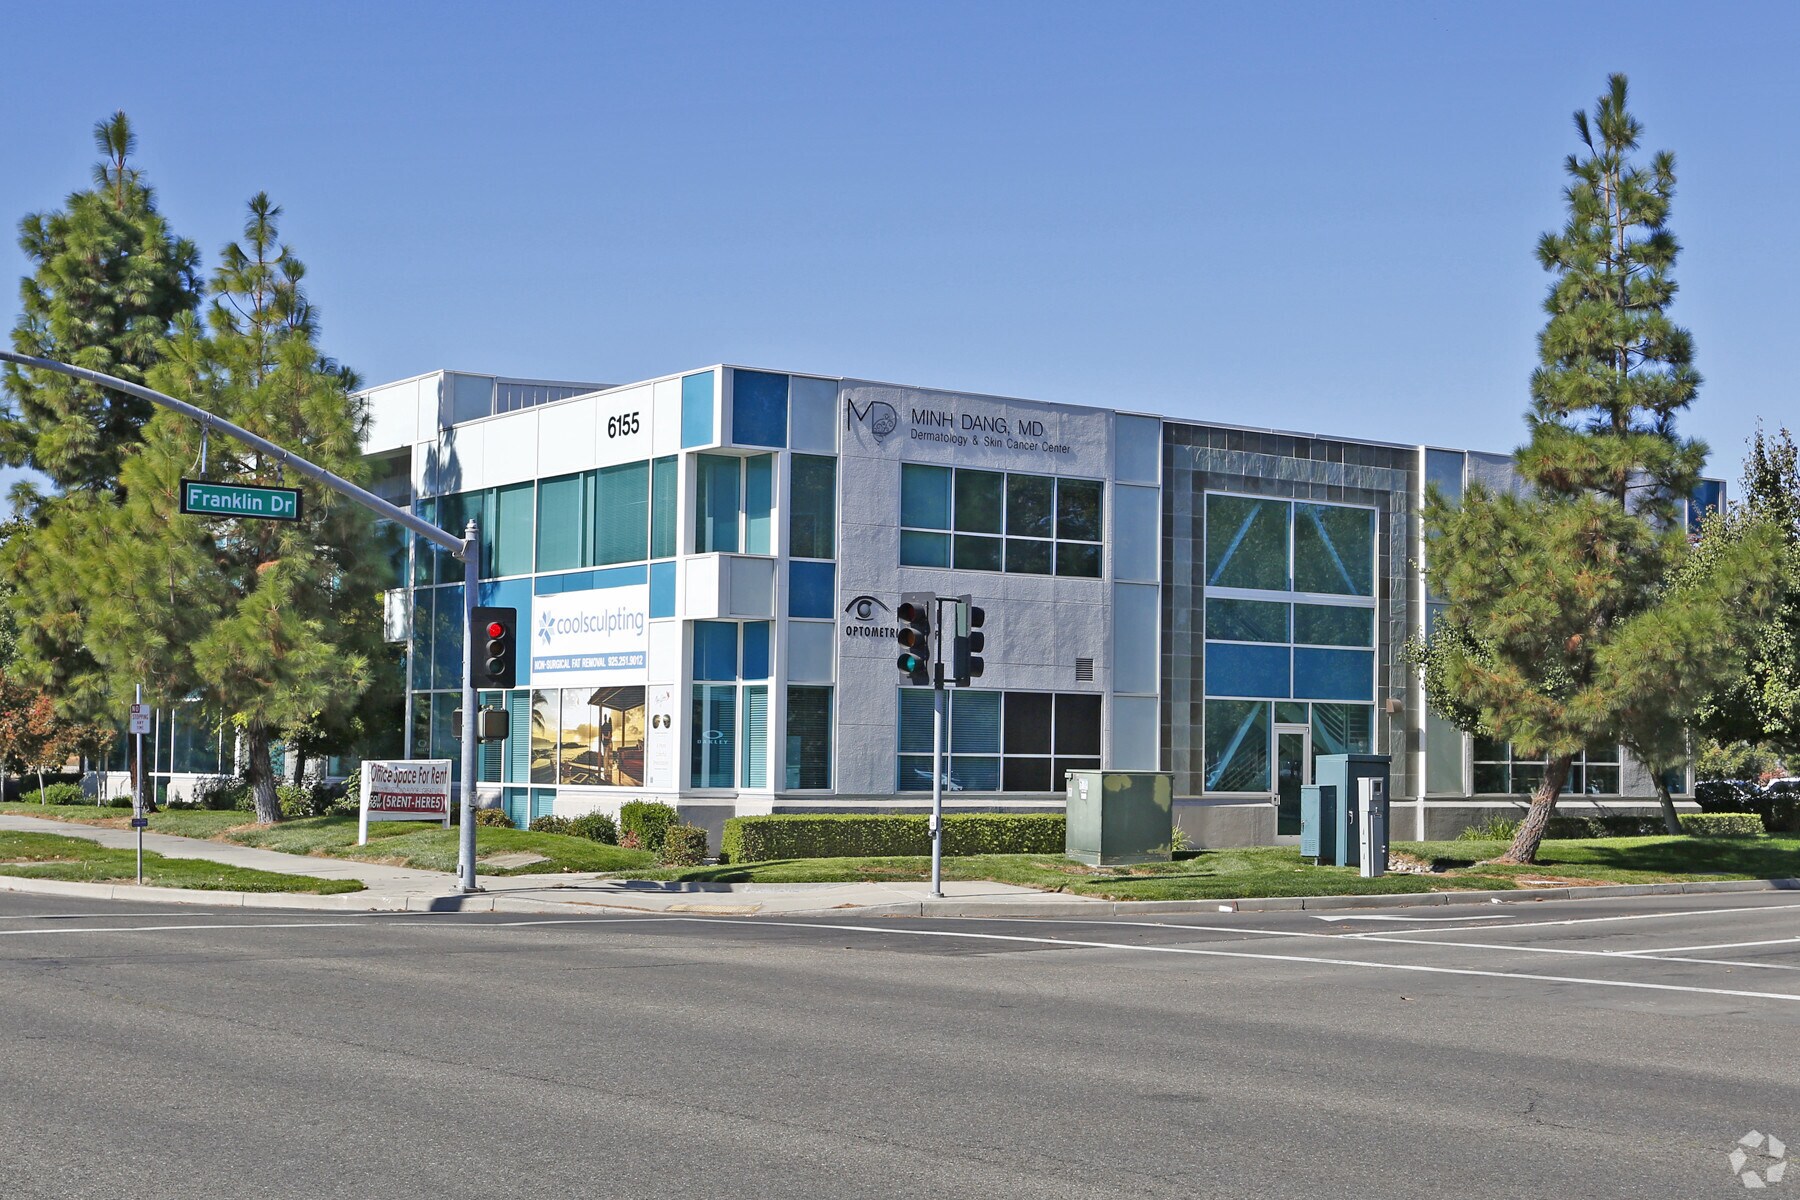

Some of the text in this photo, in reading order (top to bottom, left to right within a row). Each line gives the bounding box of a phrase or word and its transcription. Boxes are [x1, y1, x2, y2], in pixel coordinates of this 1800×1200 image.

[608, 411, 640, 439] 6155
[911, 408, 1044, 437] MINH DANG, MD
[910, 428, 1071, 454] Dermatology & Skin Cancer Center
[190, 488, 293, 513] Franklin Dr
[557, 606, 644, 637] coolsculpting
[846, 625, 899, 638] OPTOMETRI
[534, 658, 571, 670] NON-SURGICAL
[571, 657, 581, 669] FAT
[581, 656, 606, 668] REMOVAL
[371, 764, 448, 787] Office Space For Rent
